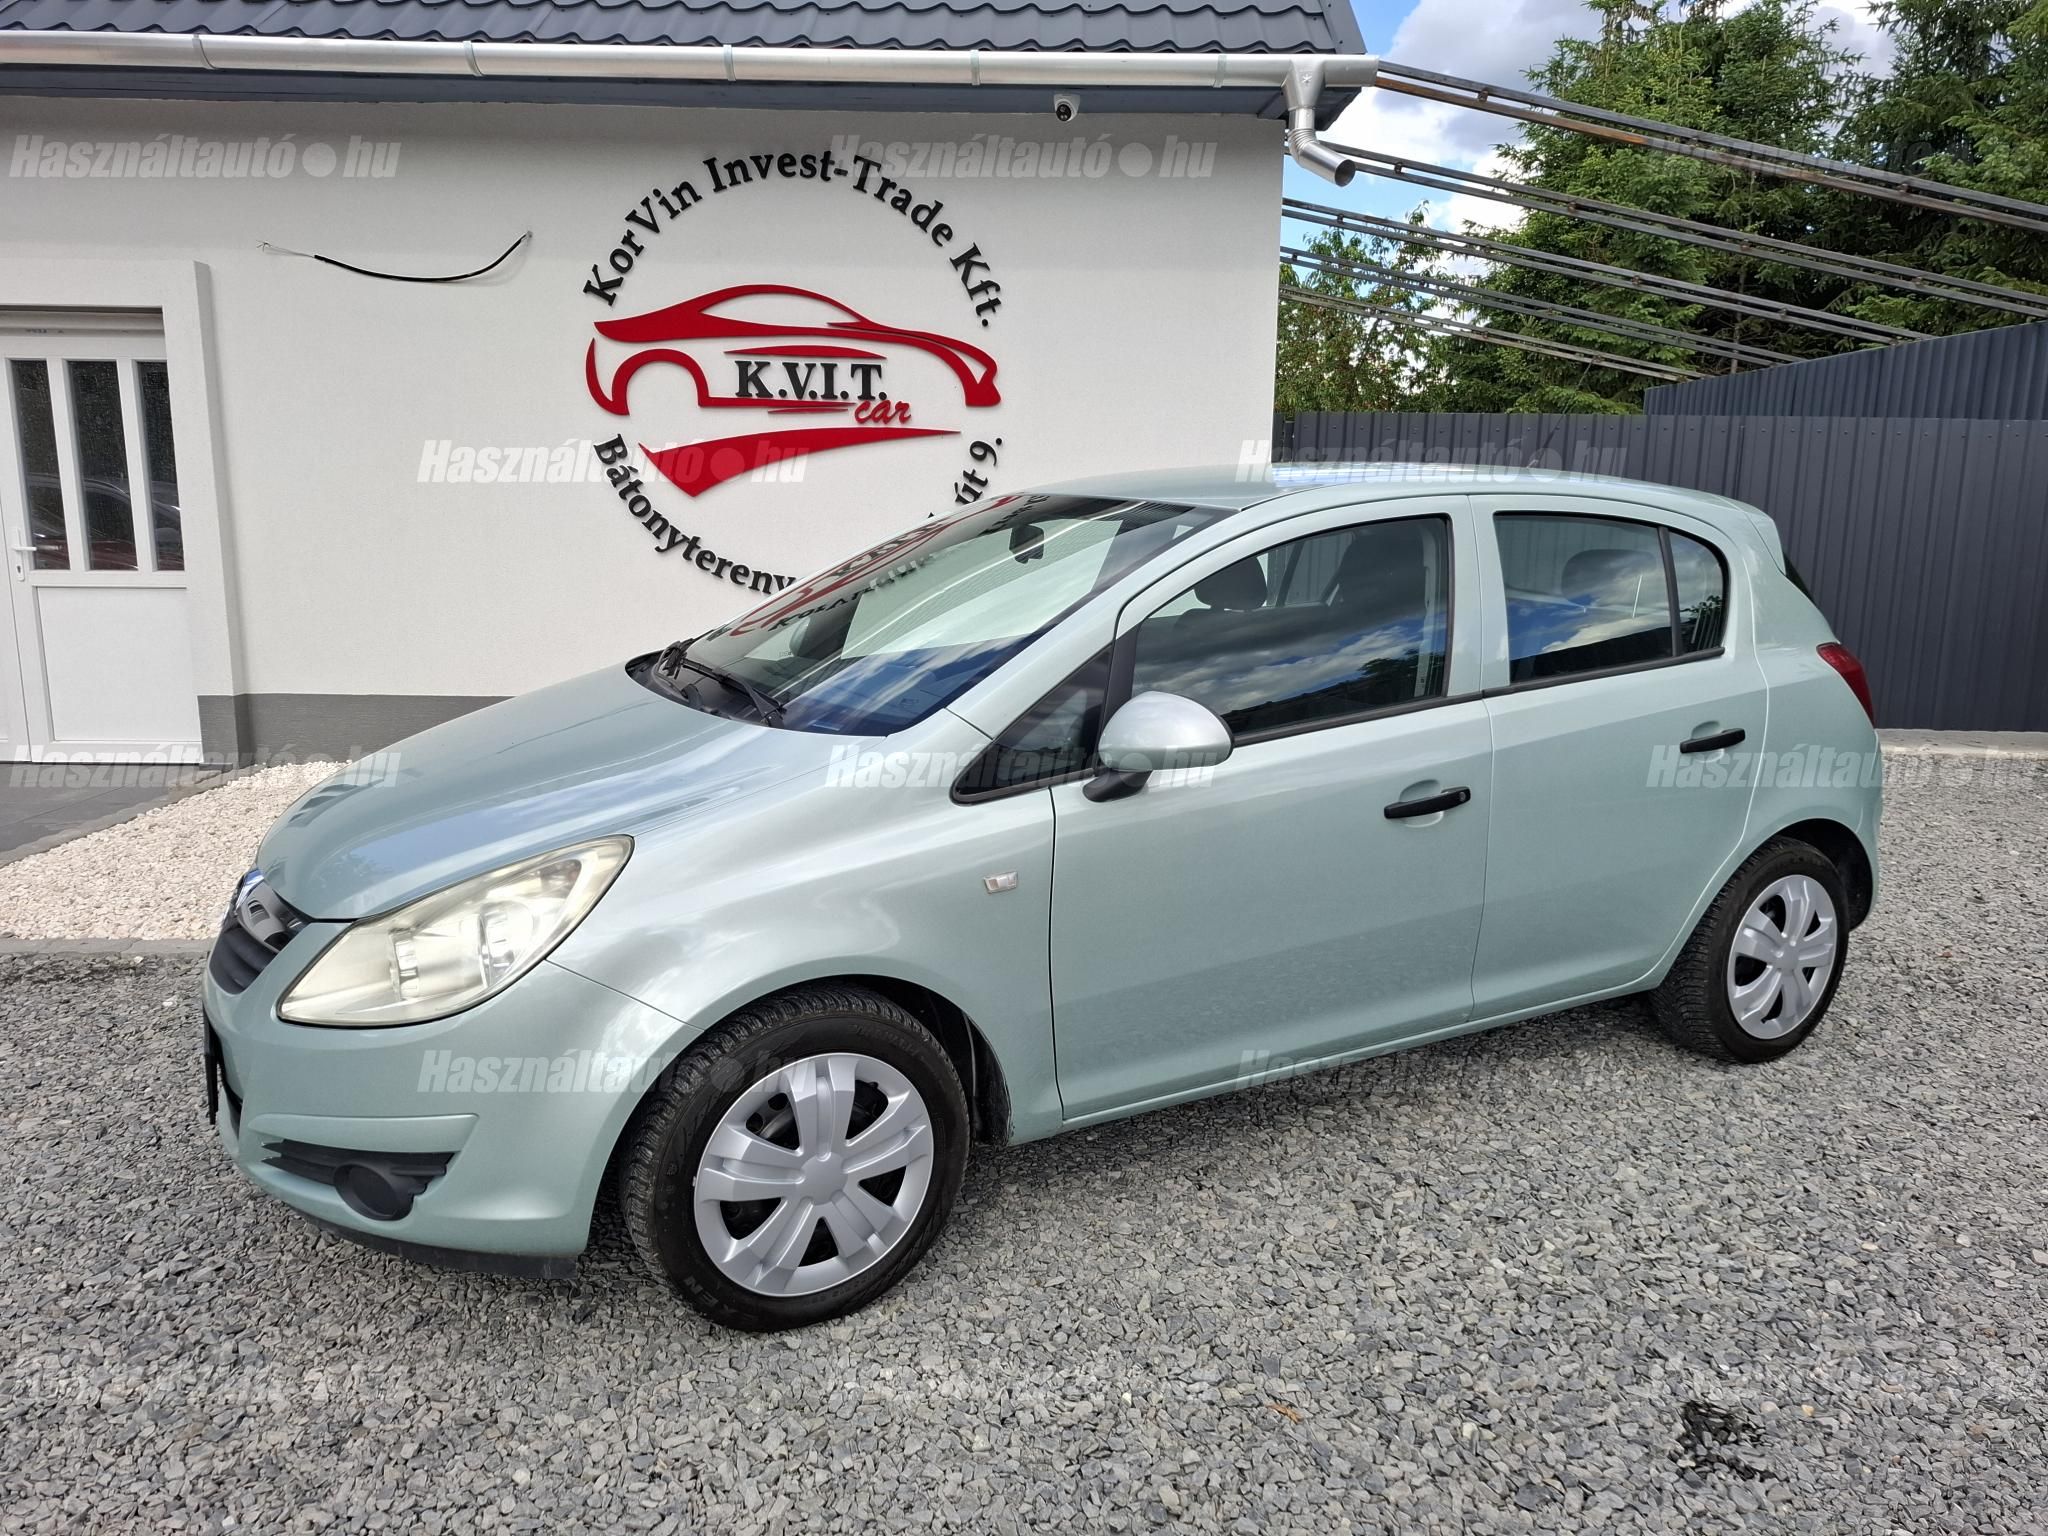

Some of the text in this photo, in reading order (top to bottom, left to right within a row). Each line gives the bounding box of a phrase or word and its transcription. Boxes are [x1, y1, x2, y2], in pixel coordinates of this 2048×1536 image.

[582, 149, 1002, 327] KorVin Invest-Trade Kft.
[734, 360, 888, 401] K.V.I.T.
[854, 400, 912, 425] car
